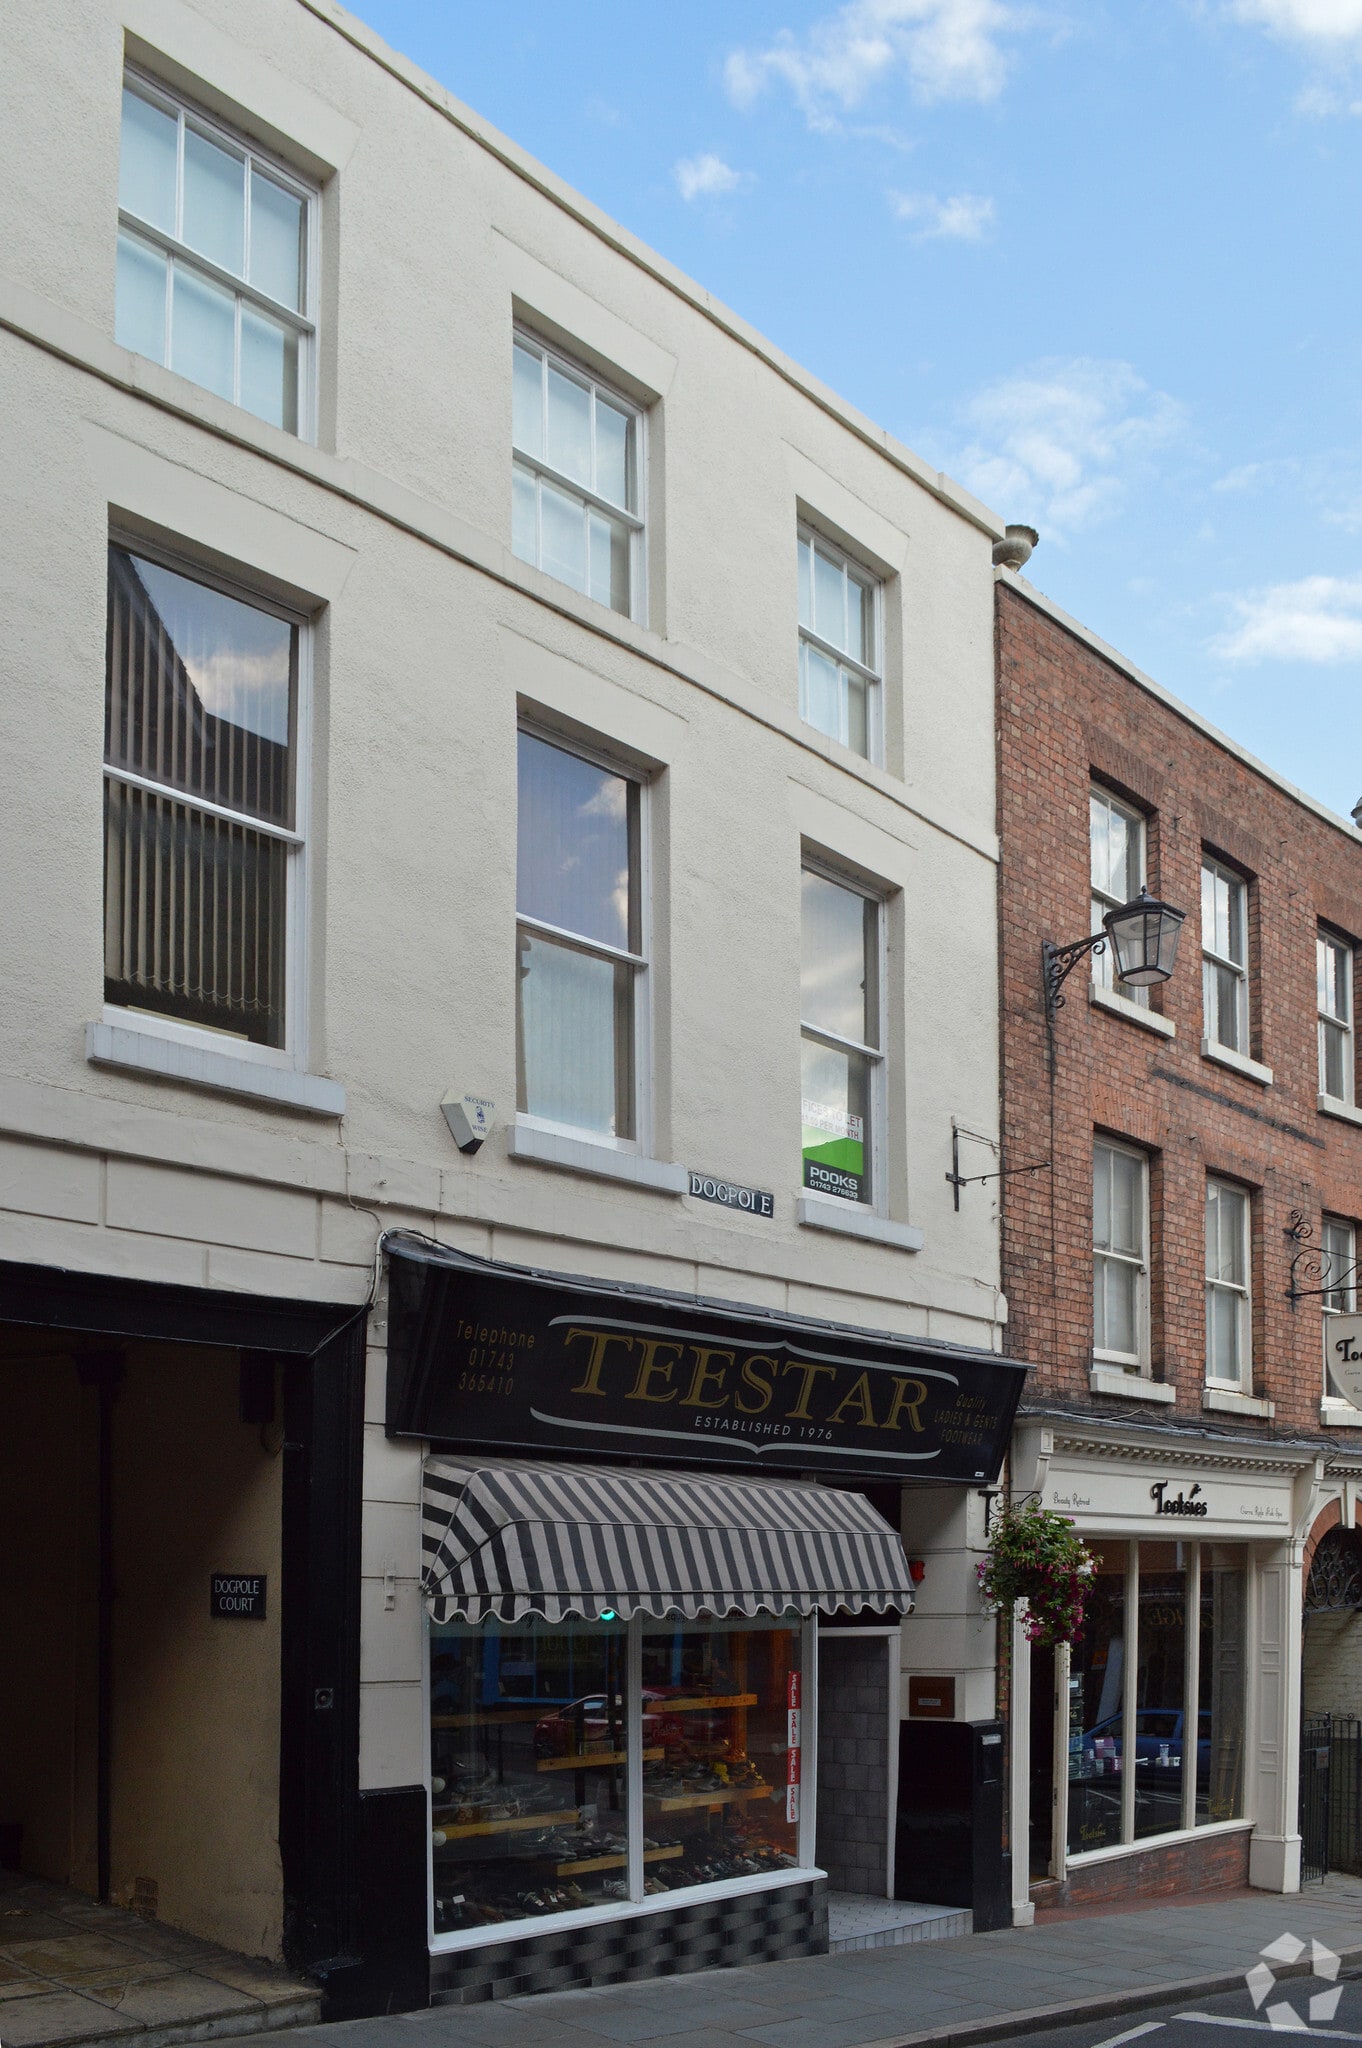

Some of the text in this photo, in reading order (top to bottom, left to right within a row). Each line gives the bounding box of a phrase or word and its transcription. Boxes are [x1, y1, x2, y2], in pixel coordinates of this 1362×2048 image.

[464, 1096, 496, 1109] SECURITY
[810, 1166, 858, 1190] POOKS
[810, 1180, 831, 1191] 01743
[457, 1320, 535, 1348] Telephone
[469, 1348, 514, 1371] 01743
[1335, 1335, 1362, 1362] To
[459, 1371, 514, 1395] 365410
[564, 1327, 929, 1433] TEESTAR
[695, 1415, 833, 1440] ESTABLISHED 1976
[934, 1409, 963, 1425] LADIES
[973, 1413, 998, 1430] GENTS
[941, 1428, 984, 1446] FOOTWEAR
[214, 1579, 259, 1595] DOGPOLE
[219, 1596, 254, 1612] COURT
